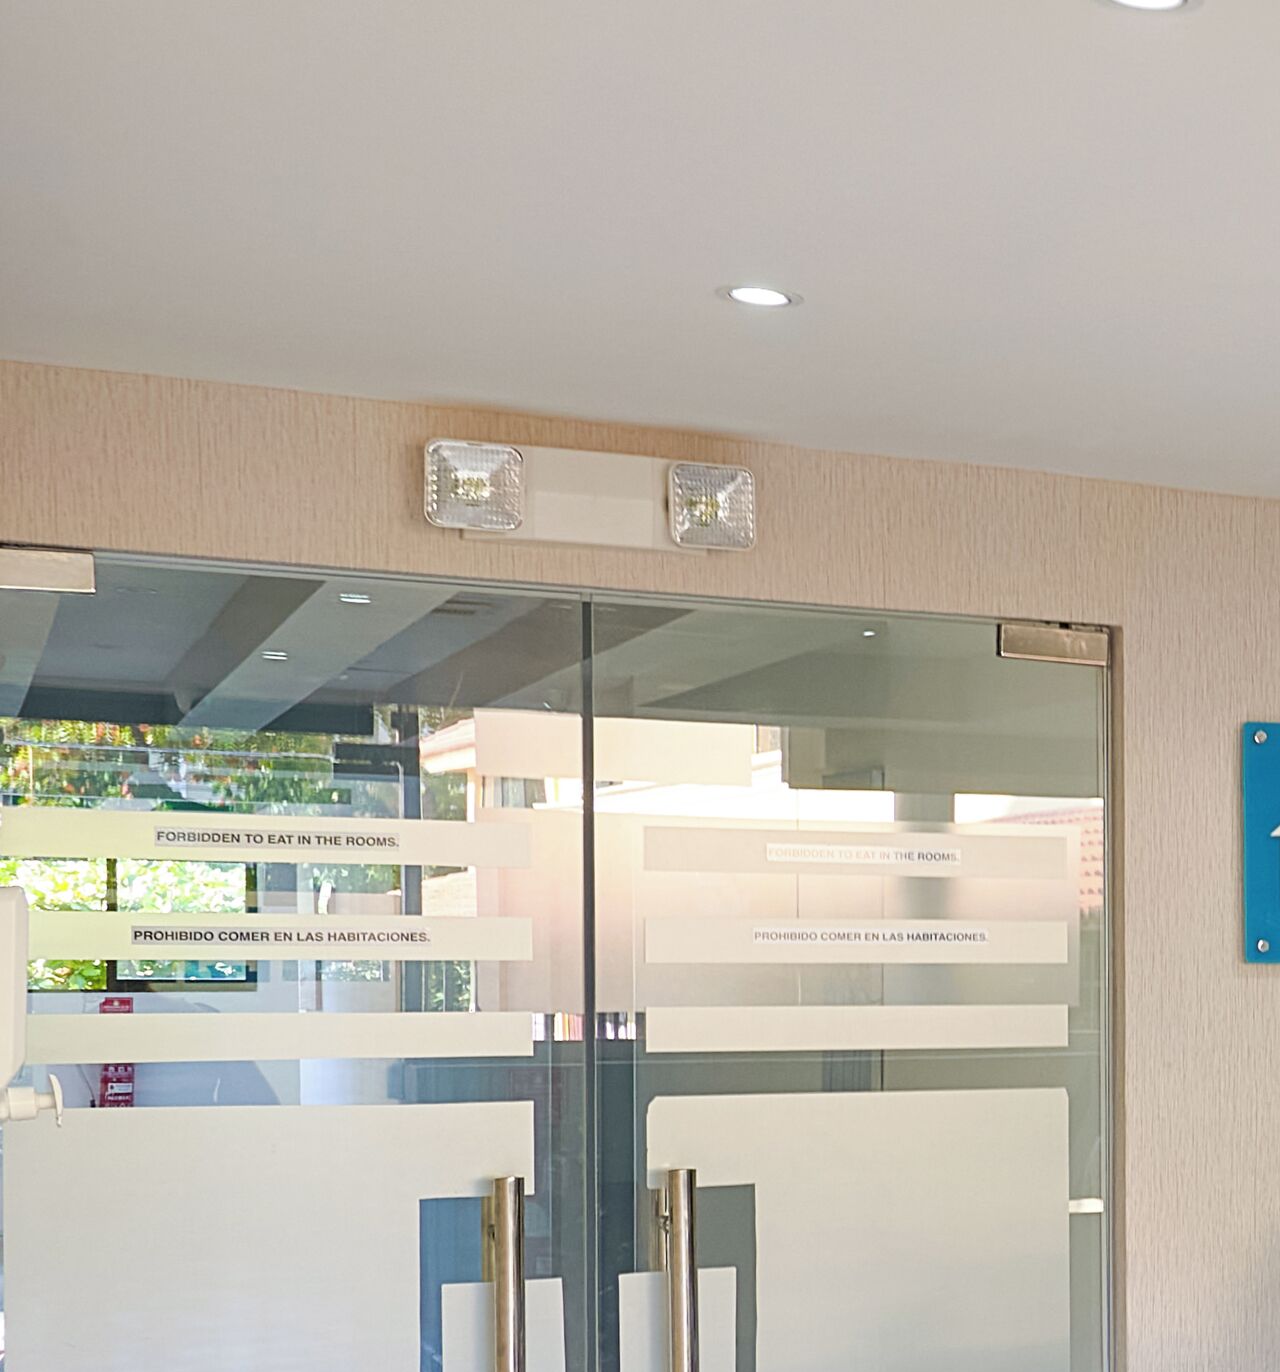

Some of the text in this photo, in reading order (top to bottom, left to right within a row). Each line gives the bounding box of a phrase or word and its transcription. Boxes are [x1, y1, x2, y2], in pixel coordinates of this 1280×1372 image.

[156, 831, 400, 848] FORBIDDEN TO EAT IN THE ROOMS.
[768, 847, 960, 862] FORBIDDEN TO EAT IN THE ROOMS.
[133, 930, 431, 943] PROHIBIDO COMER EN LAS HABITACIONES.
[754, 931, 818, 942] PROHIBIDO
[820, 931, 862, 942] COMER
[864, 932, 879, 942] EN
[882, 932, 904, 942] LAS
